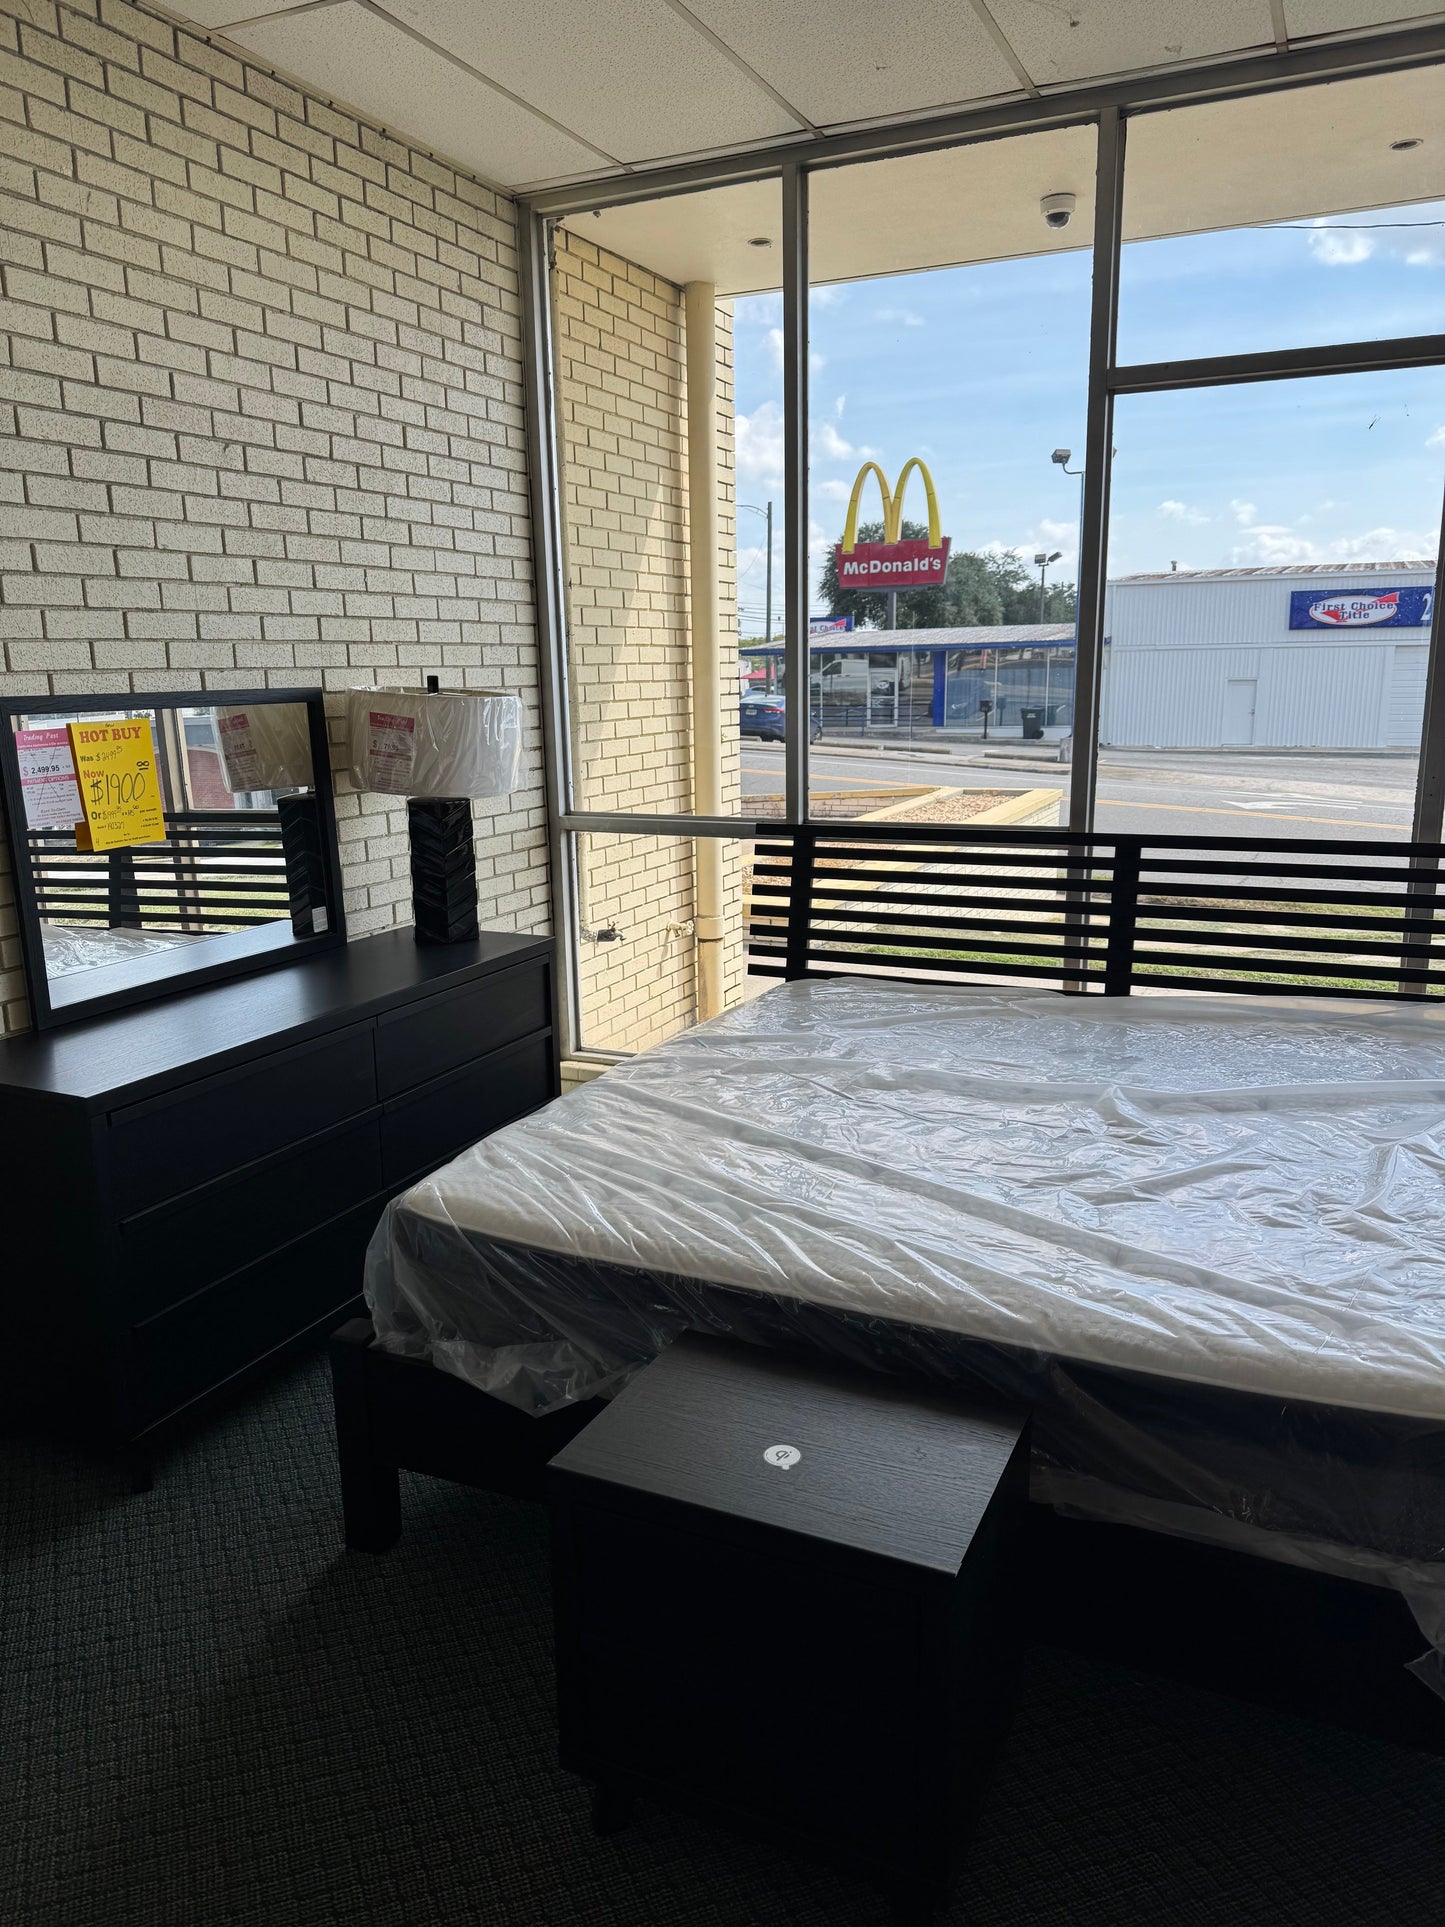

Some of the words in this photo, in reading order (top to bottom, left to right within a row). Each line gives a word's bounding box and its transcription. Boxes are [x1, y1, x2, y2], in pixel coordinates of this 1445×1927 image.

[843, 557, 941, 575] McDonald's
[1313, 603, 1345, 611] First
[1351, 601, 1394, 610] Choice
[1339, 611, 1370, 619] Title
[79, 729, 109, 743] HOT
[112, 727, 142, 741] BUY
[80, 754, 94, 762] Was
[83, 770, 104, 779] Now
[91, 811, 101, 820] Or
